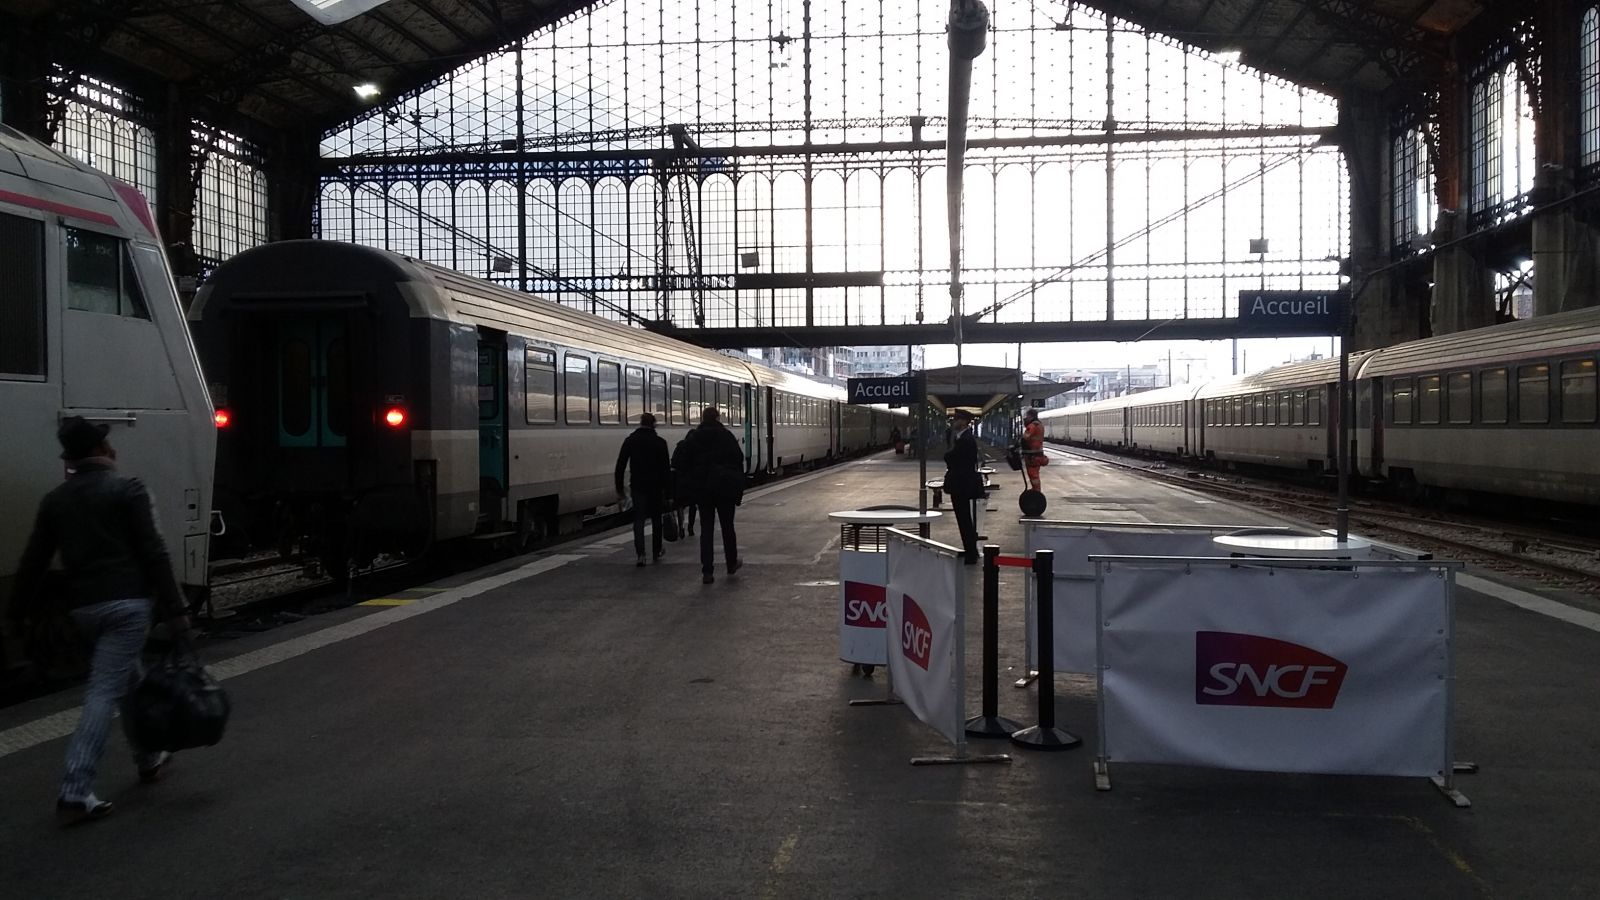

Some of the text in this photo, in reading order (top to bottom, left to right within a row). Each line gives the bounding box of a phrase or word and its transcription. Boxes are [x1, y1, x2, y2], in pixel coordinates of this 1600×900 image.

[1251, 295, 1330, 315] Accueil
[855, 381, 910, 397] Accueil
[846, 600, 888, 622] SNC
[903, 621, 931, 658] SNCF
[1202, 662, 1336, 698] SNCF
